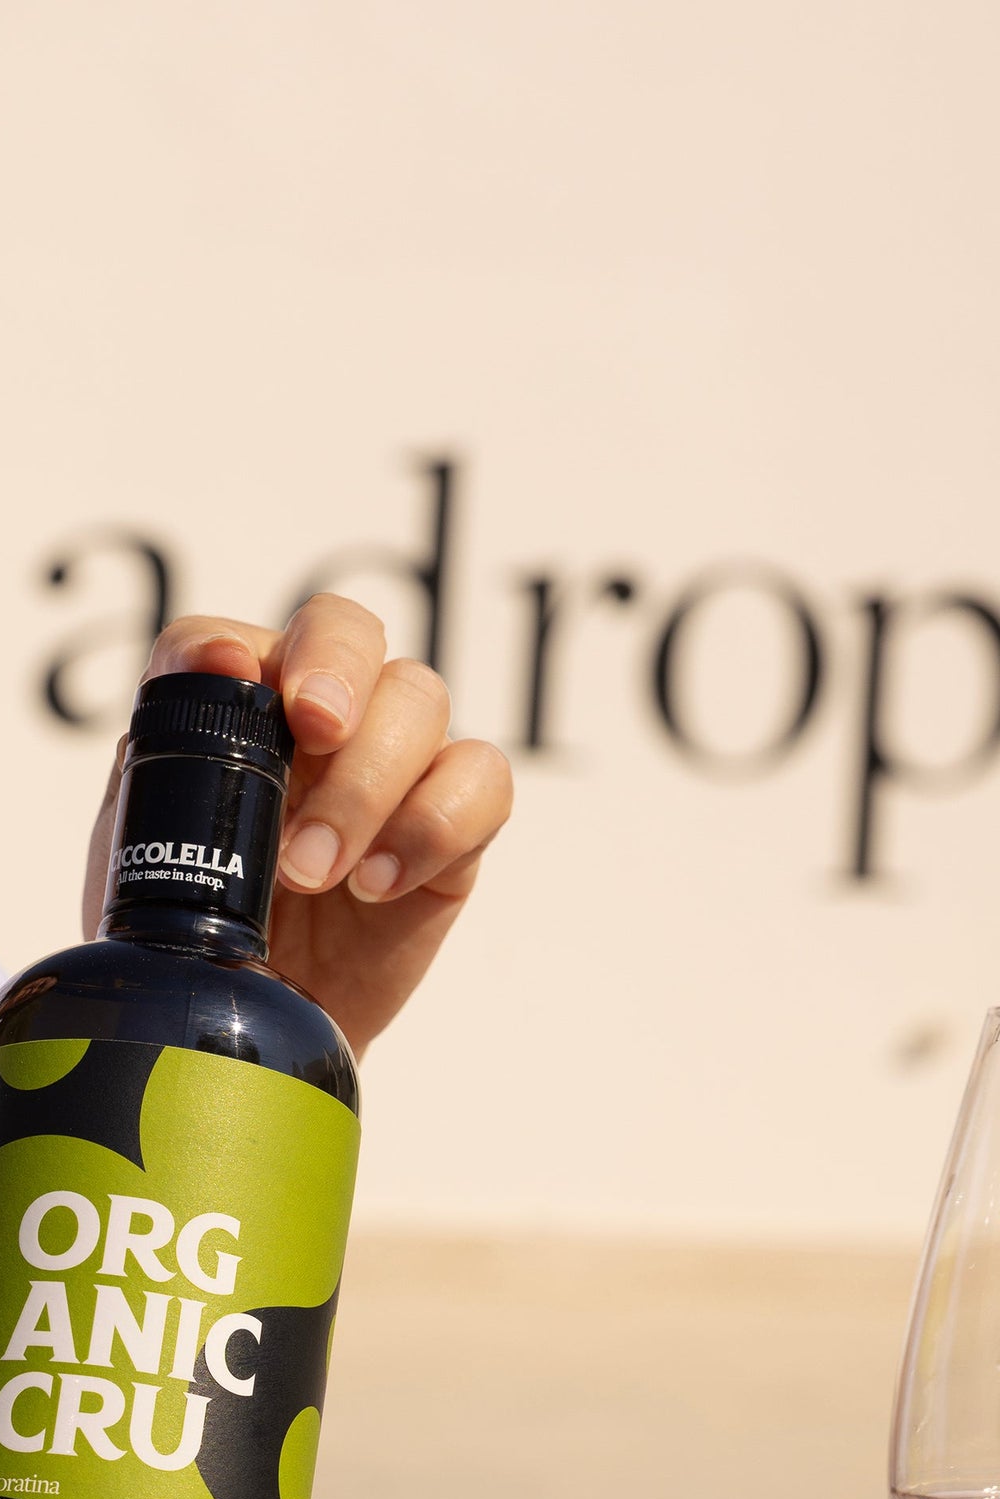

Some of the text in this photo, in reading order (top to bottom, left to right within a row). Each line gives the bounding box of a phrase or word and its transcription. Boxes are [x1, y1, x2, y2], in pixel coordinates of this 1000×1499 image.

[35, 518, 178, 735] a
[128, 869, 143, 882] the
[144, 868, 171, 880] taste
[171, 868, 184, 880] in
[185, 872, 193, 882] a
[194, 871, 225, 891] drop.
[18, 1190, 244, 1296] ORG
[0, 1280, 263, 1397] ANIC
